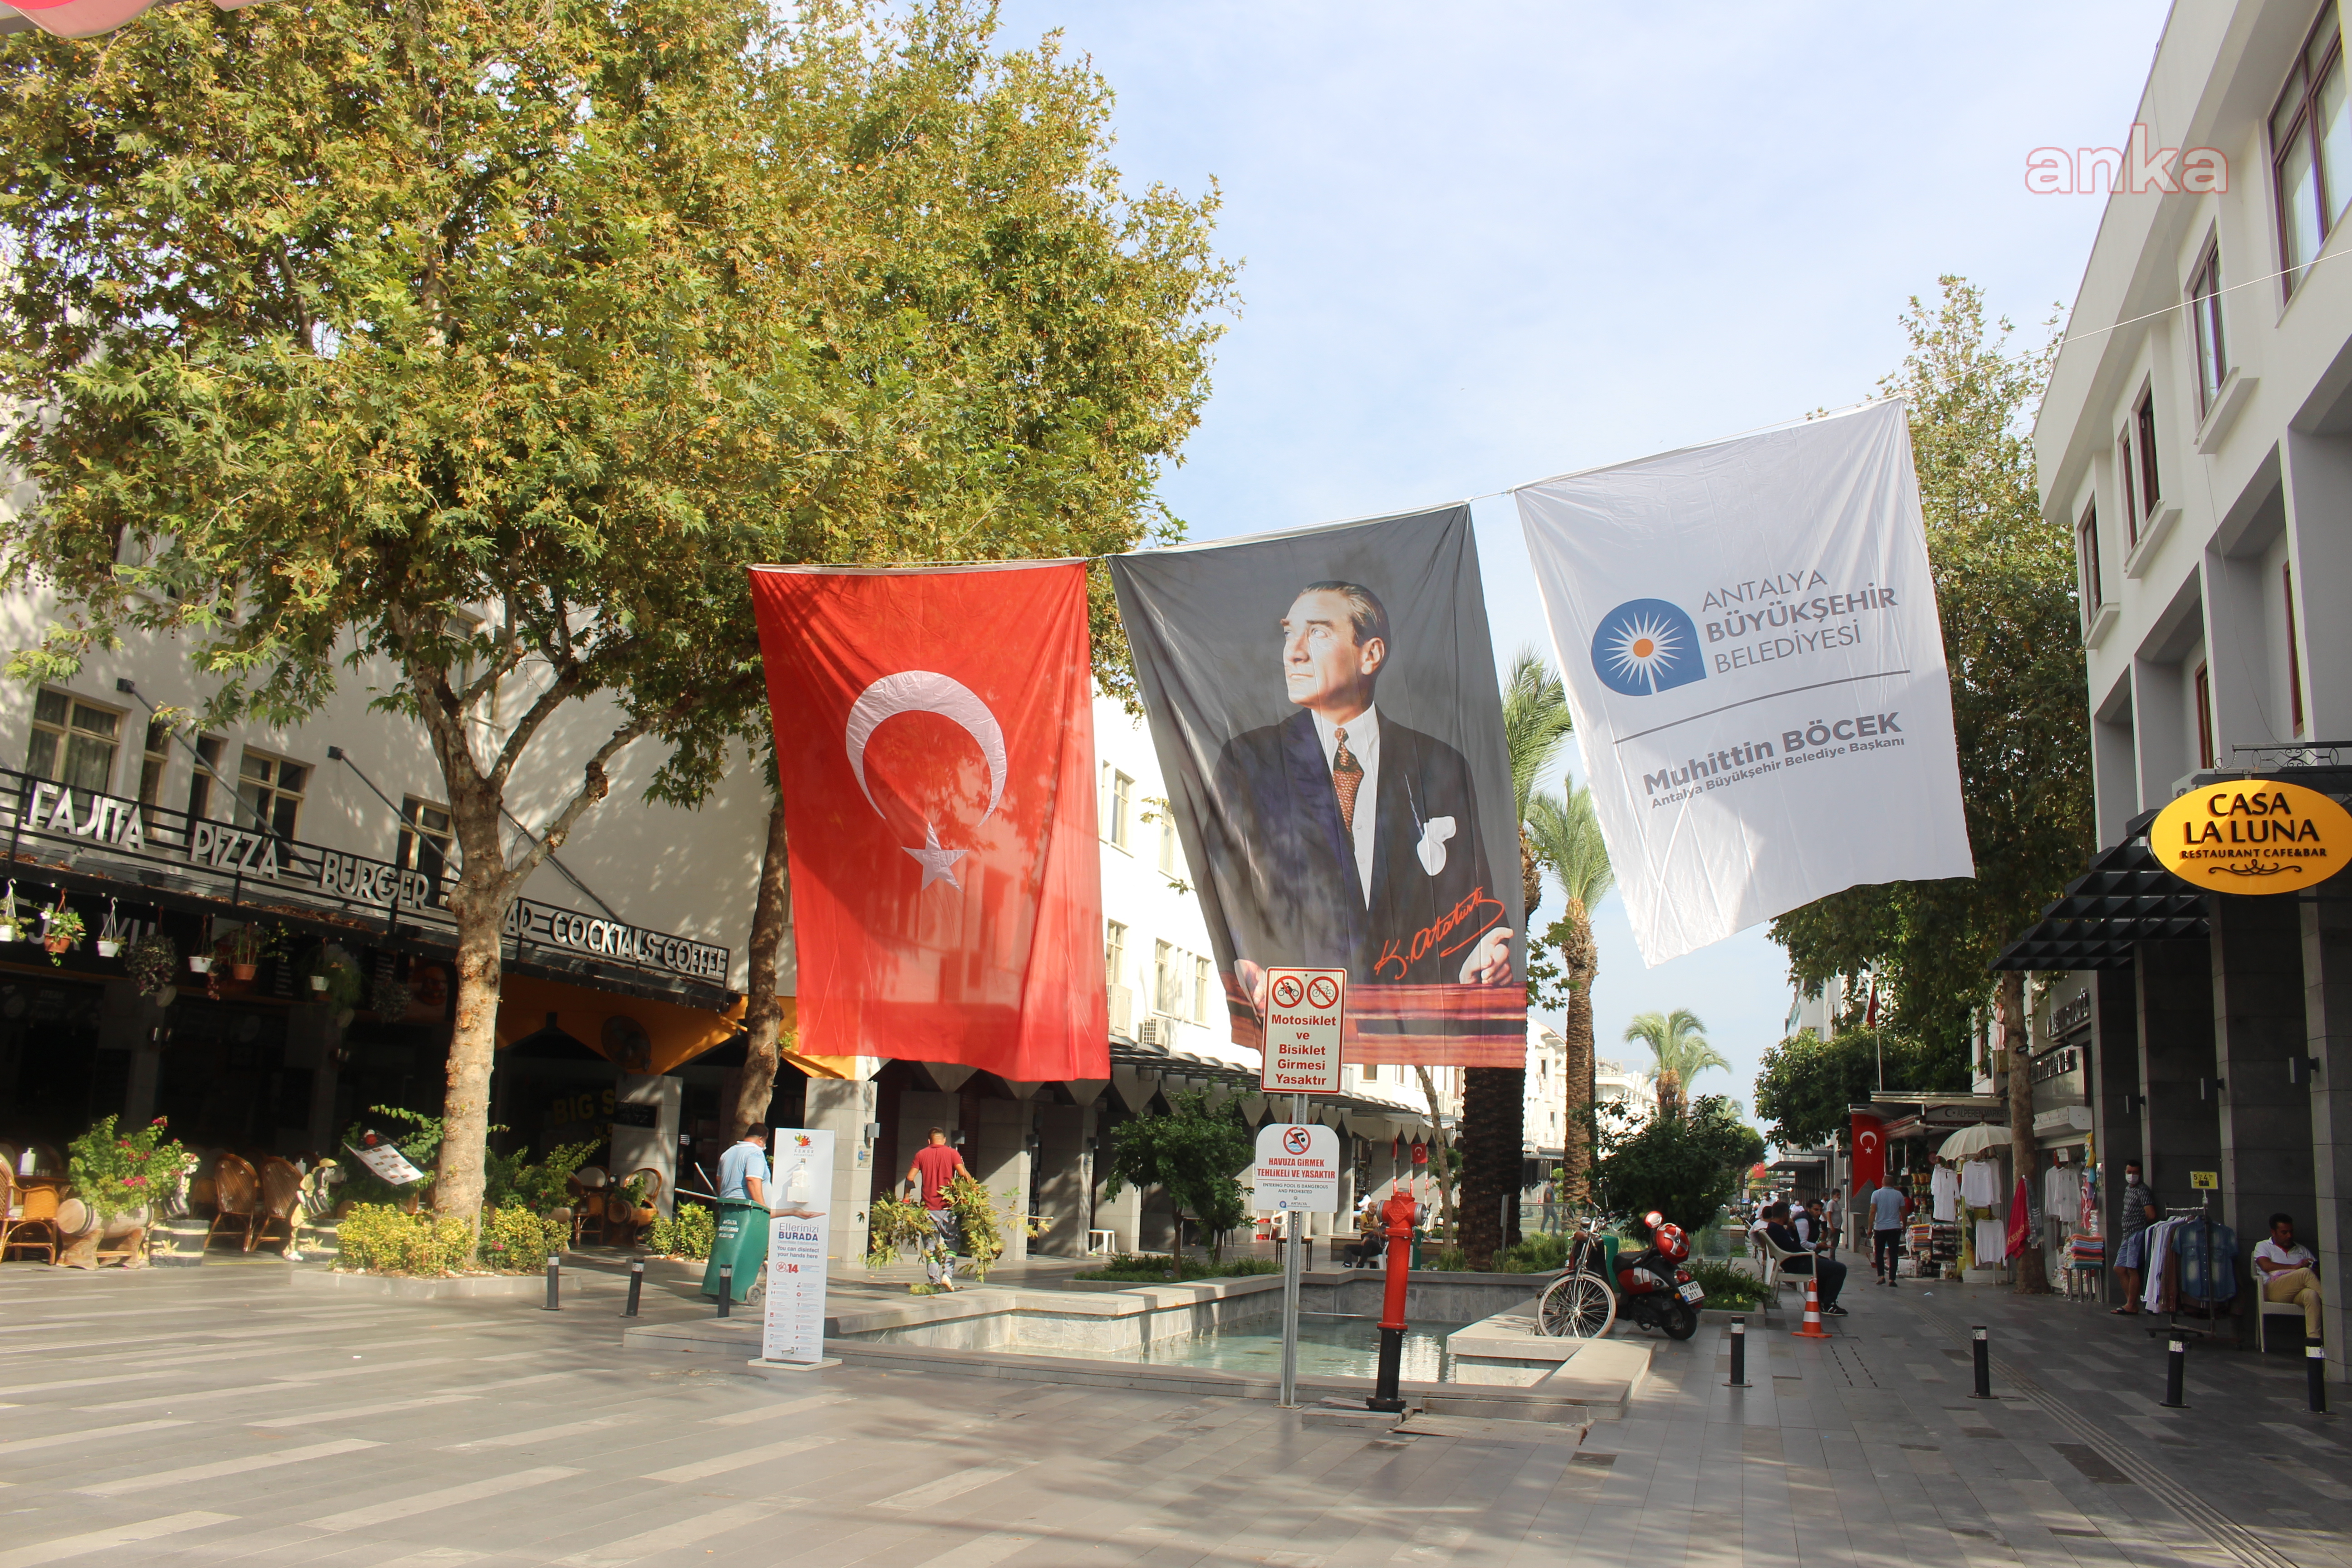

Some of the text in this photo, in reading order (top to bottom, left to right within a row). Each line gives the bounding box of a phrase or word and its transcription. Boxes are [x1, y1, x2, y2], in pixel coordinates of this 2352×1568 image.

[1702, 569, 1828, 612] ANTALYA
[1705, 582, 1898, 643] BÜYÜKŞEHİR
[1714, 619, 1861, 674] BELEDİYESİ
[1642, 711, 1902, 795] Muhittin BÖCEK
[1651, 737, 1905, 809] Antalya Büyükşehir Belediye Başkanı
[2207, 792, 2291, 817] CASA
[2183, 818, 2320, 845] LA LUNA
[2179, 848, 2327, 859] RESTAURANT CAFE&BAR
[28, 780, 146, 850] FAJITA
[190, 821, 279, 879] PIZZA
[321, 851, 430, 910] BURGER
[551, 911, 657, 962] COCKTAILS
[663, 938, 726, 977] COFFEE
[1271, 1014, 1336, 1026] Motosiklet
[1279, 1044, 1326, 1055] Bisiklet
[1278, 1058, 1325, 1070] Girmesi
[1275, 1073, 1327, 1085] Yasaktır
[1984, 1109, 2008, 1118] MARKET
[1269, 1158, 1296, 1166] HAVUZA
[1302, 1170, 1335, 1179] YASAKTIR
[779, 1222, 819, 1233] Ellerinizi
[779, 1231, 818, 1241] BURADA
[788, 1264, 799, 1273] 14
[1688, 1282, 1699, 1291] AKB
[1688, 1291, 1698, 1299] 311
